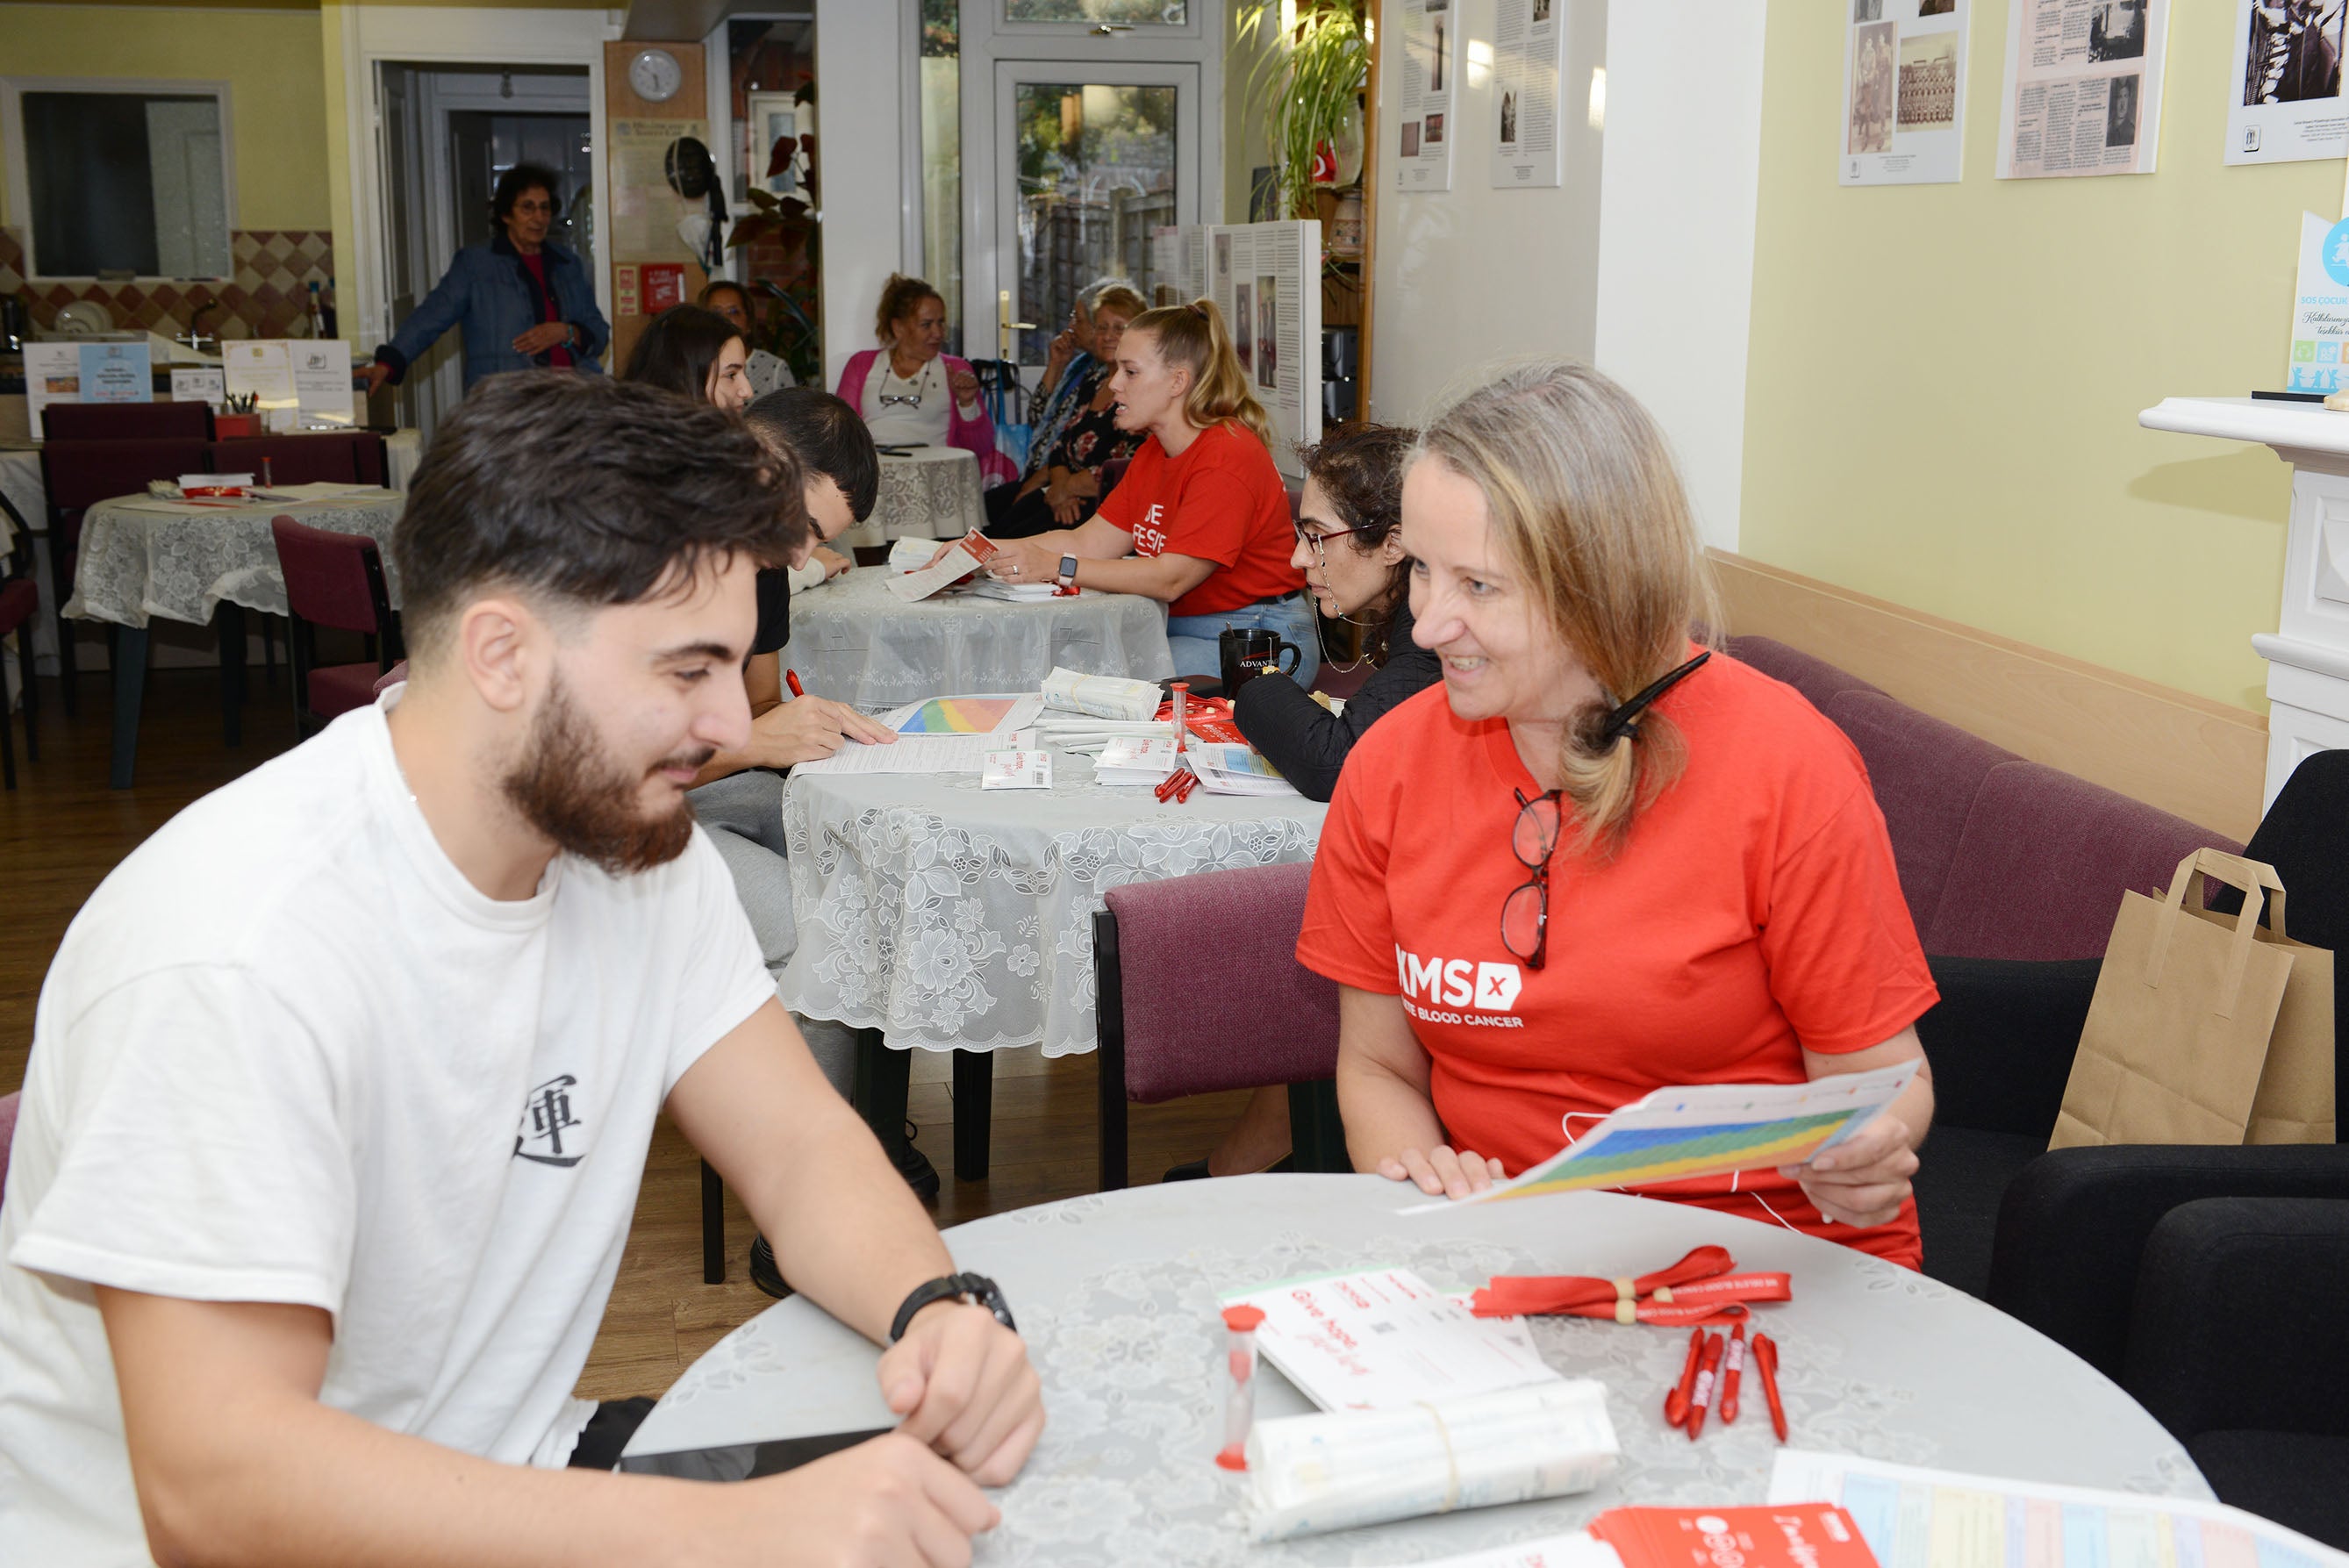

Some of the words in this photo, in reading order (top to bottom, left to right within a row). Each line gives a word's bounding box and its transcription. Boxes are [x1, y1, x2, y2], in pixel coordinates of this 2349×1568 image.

[1395, 942, 1474, 1008] KMS
[1418, 1007, 1462, 1025] BLOOD
[1465, 1013, 1524, 1028] CANCER
